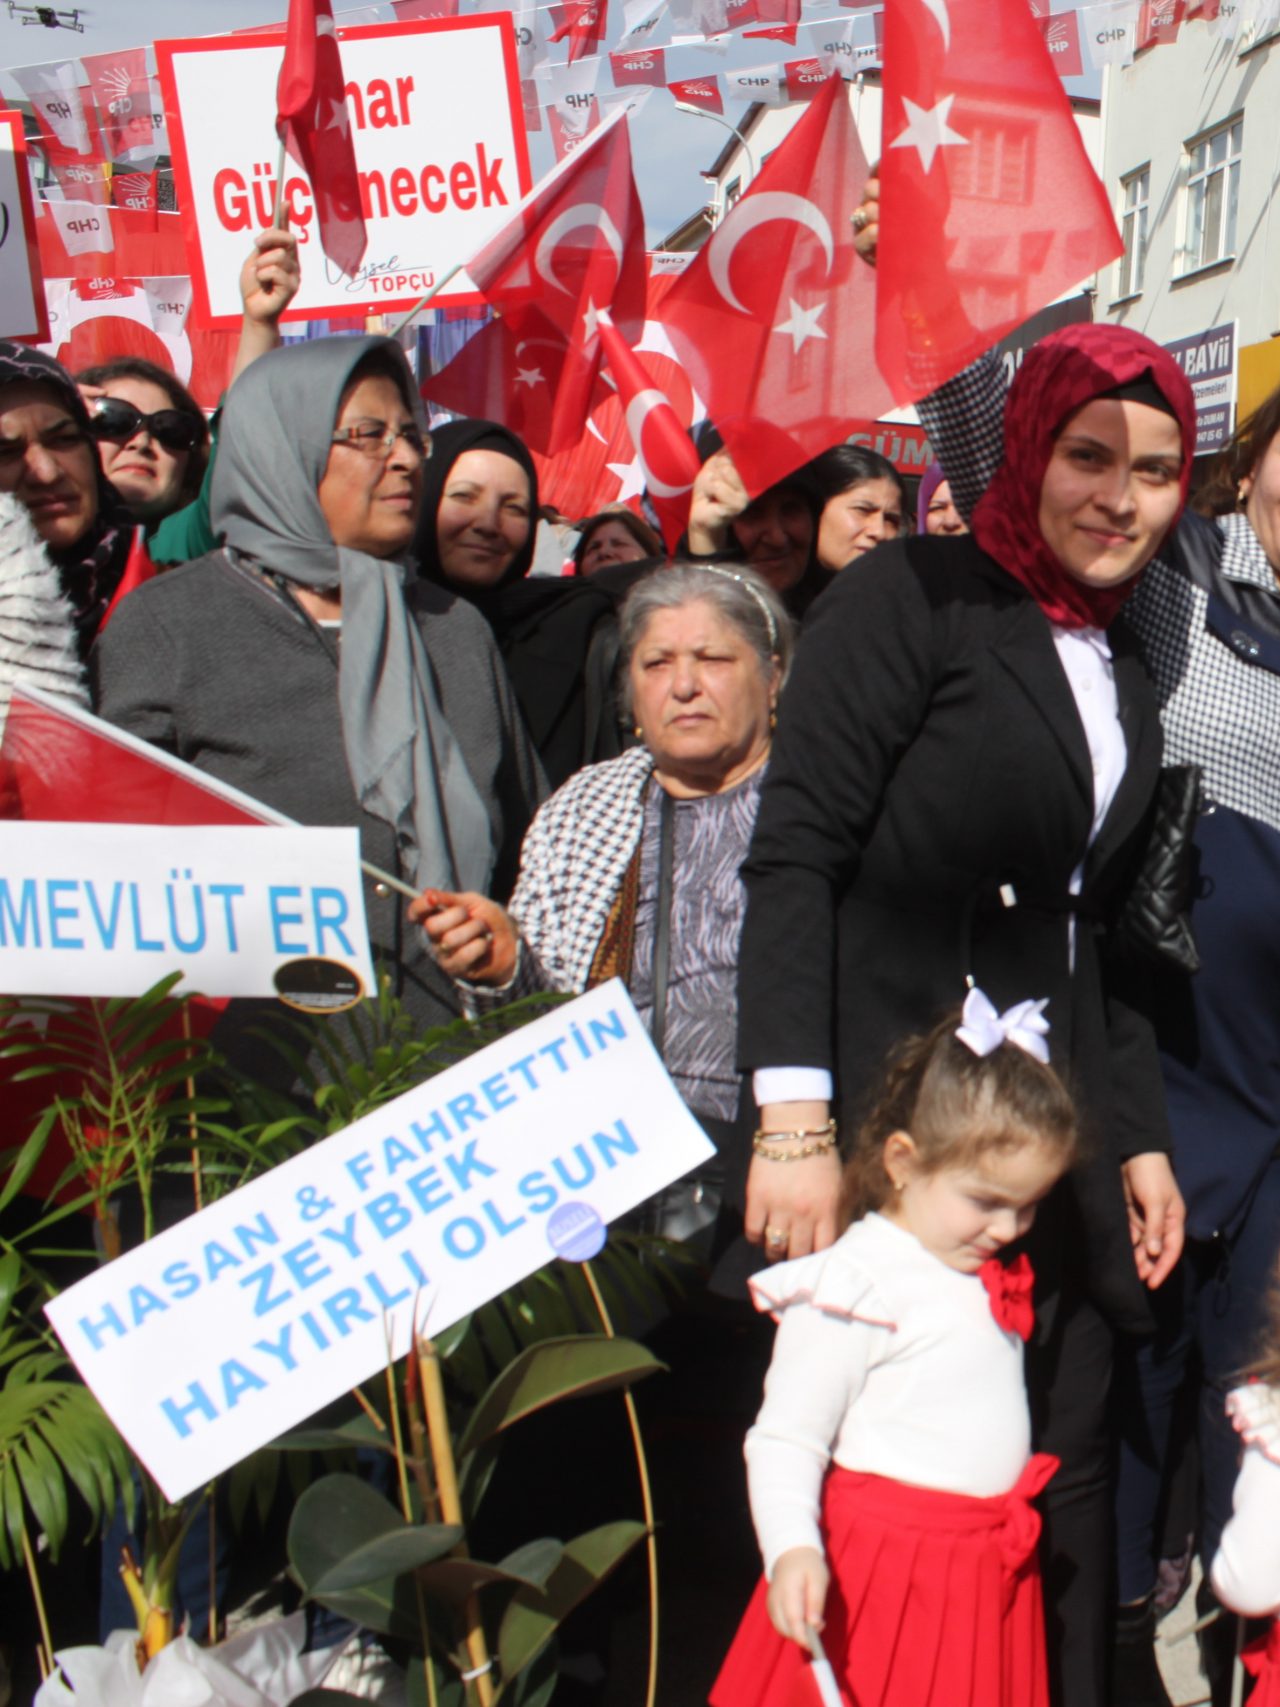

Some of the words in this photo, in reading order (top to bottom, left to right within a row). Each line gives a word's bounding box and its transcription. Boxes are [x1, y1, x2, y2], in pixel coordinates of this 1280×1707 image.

[1096, 28, 1126, 44] CHP
[1049, 41, 1069, 53] HP
[737, 77, 770, 87] CHP
[798, 74, 827, 83] CHP
[684, 89, 713, 97] CHP
[369, 272, 434, 293] TOPÇU
[0, 868, 245, 953] MEVLÜT
[268, 885, 357, 956] ER
[77, 1211, 280, 1352] HASAN
[296, 1183, 336, 1223] &
[344, 1008, 629, 1194] FAHRETTİN
[238, 1140, 499, 1318] ZEYBEK
[159, 1250, 432, 1440] HAYIRLI
[442, 1120, 642, 1262] OLSUN
